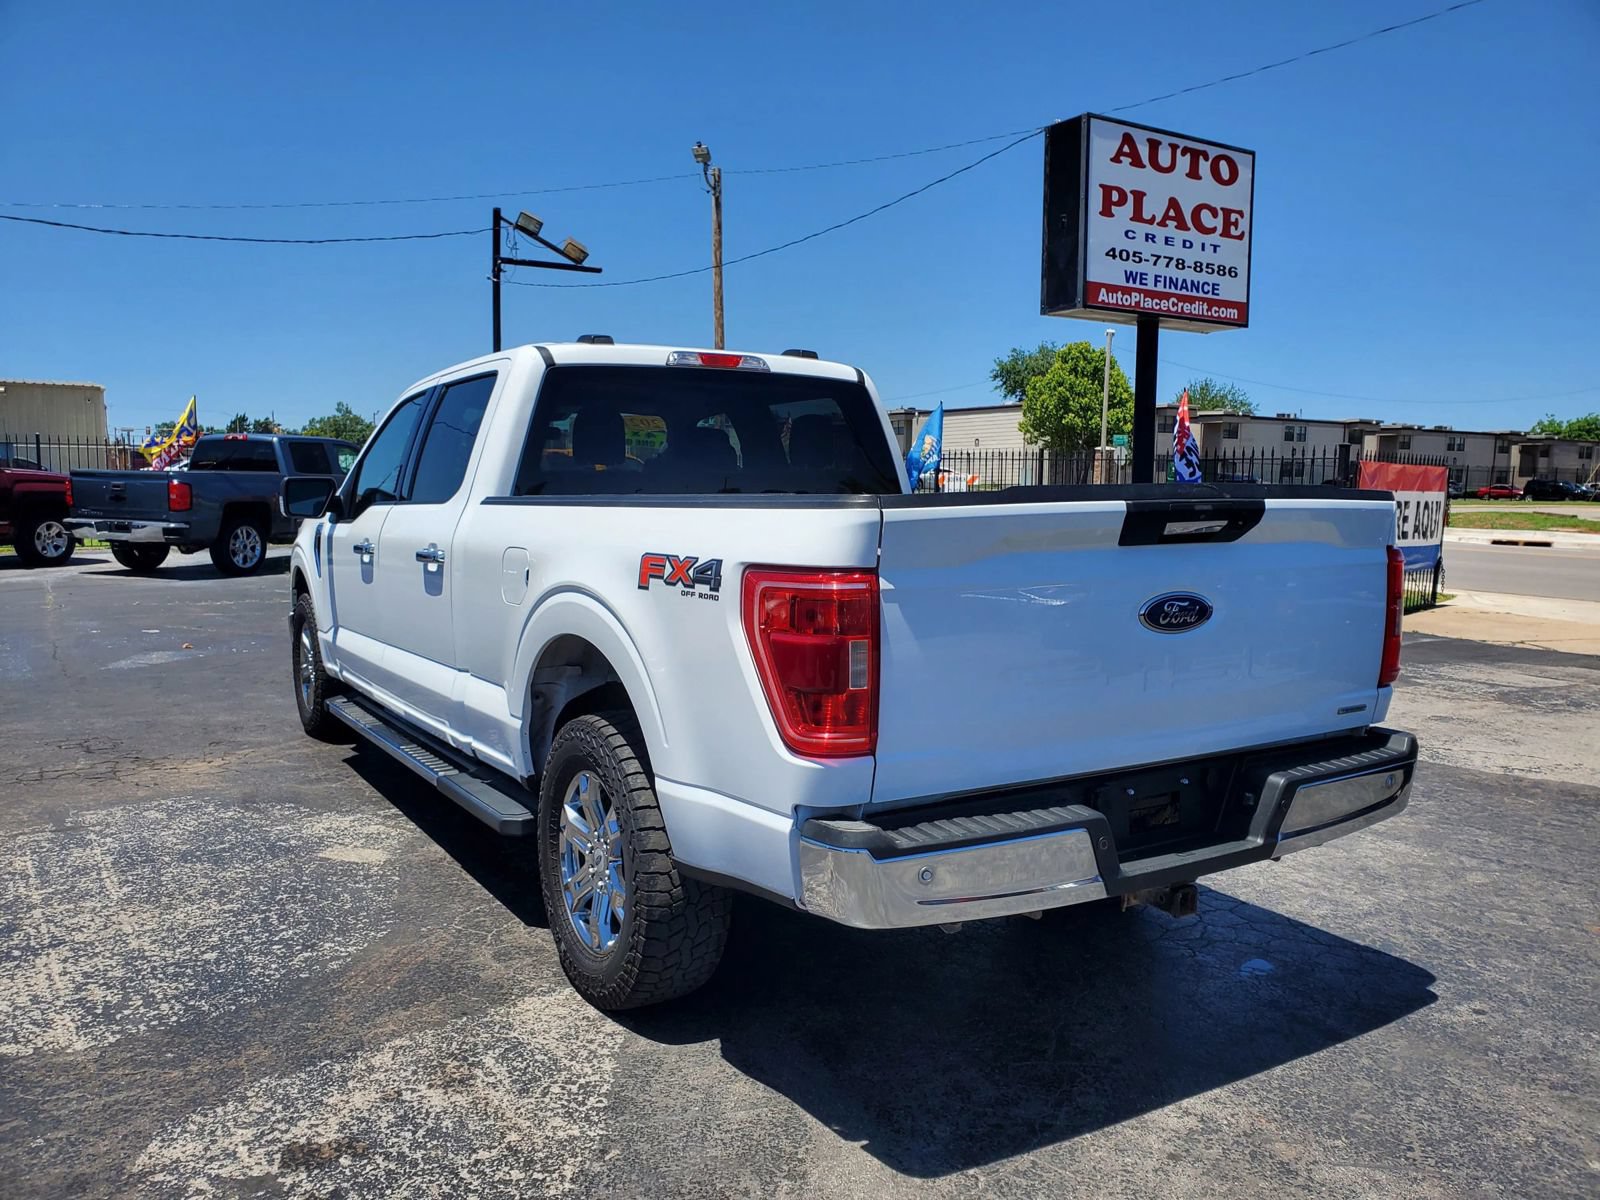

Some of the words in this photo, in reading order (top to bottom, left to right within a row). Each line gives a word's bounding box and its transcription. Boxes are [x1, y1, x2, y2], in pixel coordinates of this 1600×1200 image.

[1110, 132, 1239, 187] AUTO
[1098, 183, 1246, 241] PLACE
[1124, 229, 1221, 254] CREDIT
[1104, 247, 1239, 279] 405-778-8586
[1124, 269, 1149, 287] WE
[1153, 274, 1220, 297] FINANCE
[1097, 287, 1239, 320] AutoPlaceCredit.com
[637, 552, 724, 593] FX4
[680, 590, 696, 598] OFF
[698, 592, 720, 602] ROAD
[1160, 601, 1199, 625] Ford
